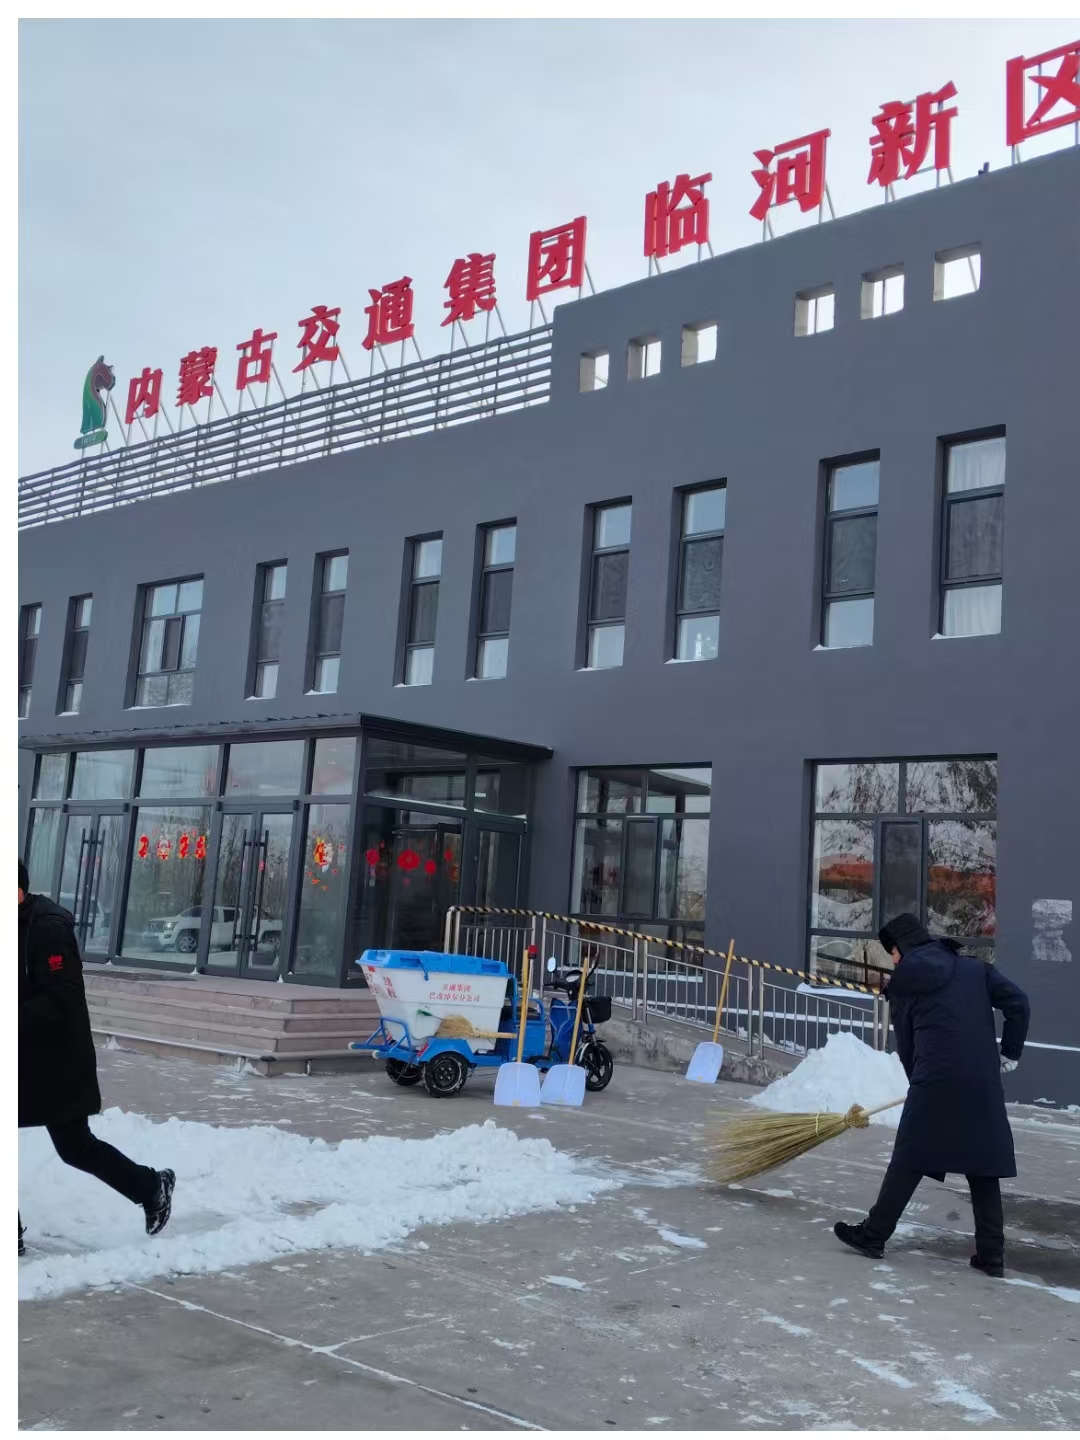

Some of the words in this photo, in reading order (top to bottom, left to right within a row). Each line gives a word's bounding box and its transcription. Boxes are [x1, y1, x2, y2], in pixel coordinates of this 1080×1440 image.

[125, 216, 587, 425] 内蒙古交通集团
